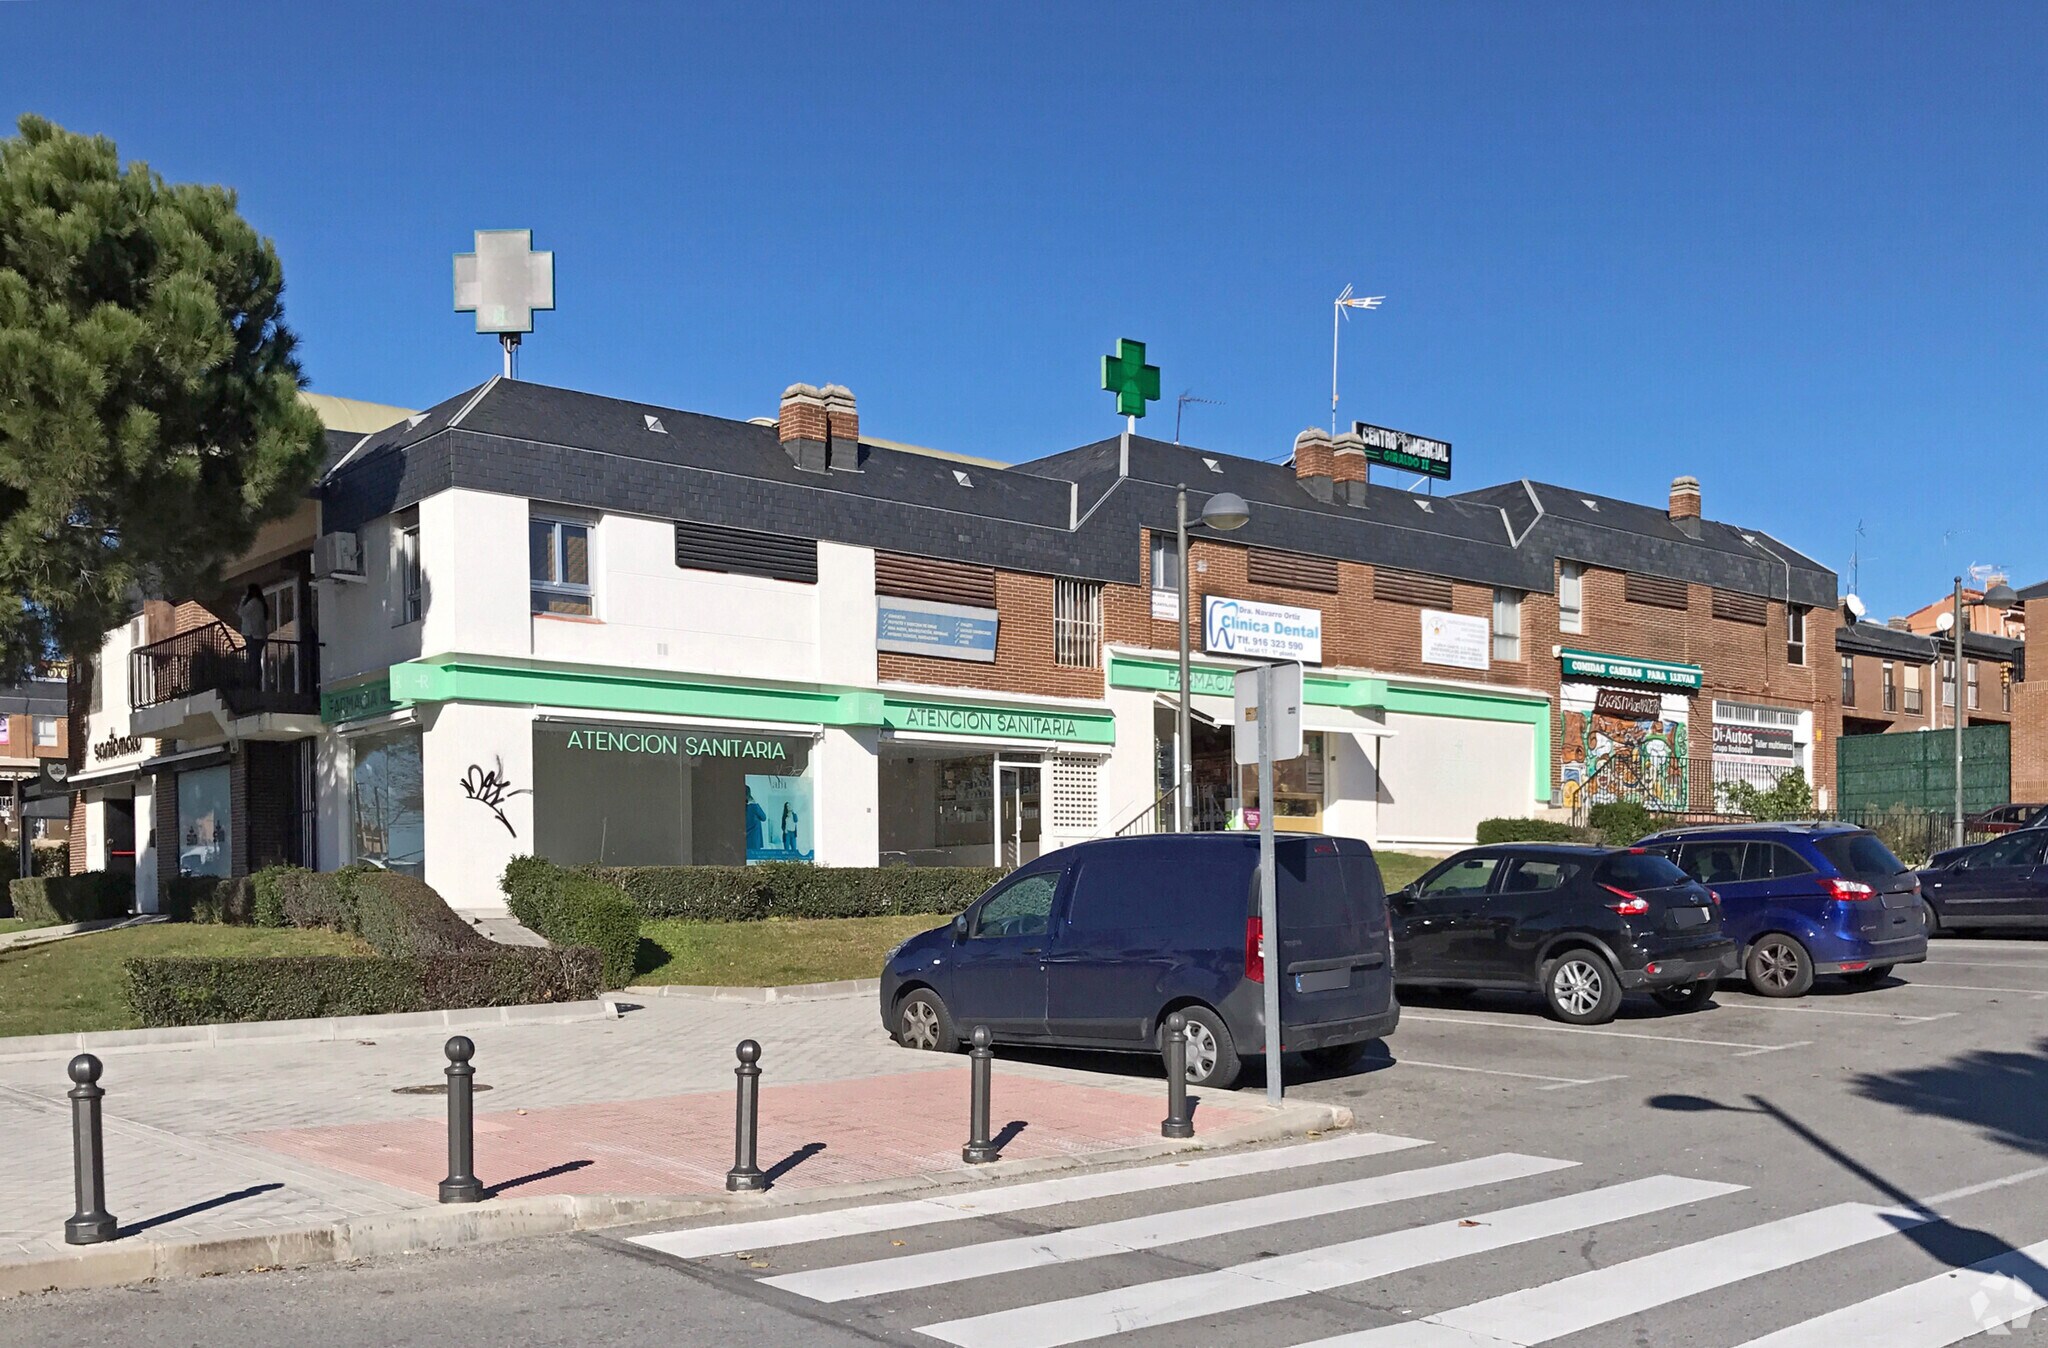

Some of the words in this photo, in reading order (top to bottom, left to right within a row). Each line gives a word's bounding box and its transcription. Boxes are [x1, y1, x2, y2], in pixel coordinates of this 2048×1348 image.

[1362, 427, 1397, 450] CENTRO
[1402, 437, 1449, 462] COMERCIAL
[1383, 450, 1420, 467] GIRALDO
[1421, 459, 1430, 470] II
[1239, 606, 1253, 614] Dra.
[1255, 609, 1283, 618] Navarro
[1284, 612, 1301, 620] Ortiz
[1274, 621, 1319, 639] Dental
[1252, 637, 1269, 647] 916
[1270, 639, 1286, 649] 323
[1288, 641, 1304, 651] 590
[1572, 660, 1606, 674] COMIDAS
[1608, 665, 1643, 678] CASERAS
[1646, 670, 1667, 681] PARA
[1669, 672, 1696, 685] LLEVAR
[997, 714, 1077, 737] SANITARIA
[1712, 726, 1753, 745] Di-Autos
[1754, 739, 1768, 749] Taller
[566, 730, 678, 755] ATENCION
[685, 736, 787, 761] SANITARIA
[1712, 743, 1728, 753] Grupo
